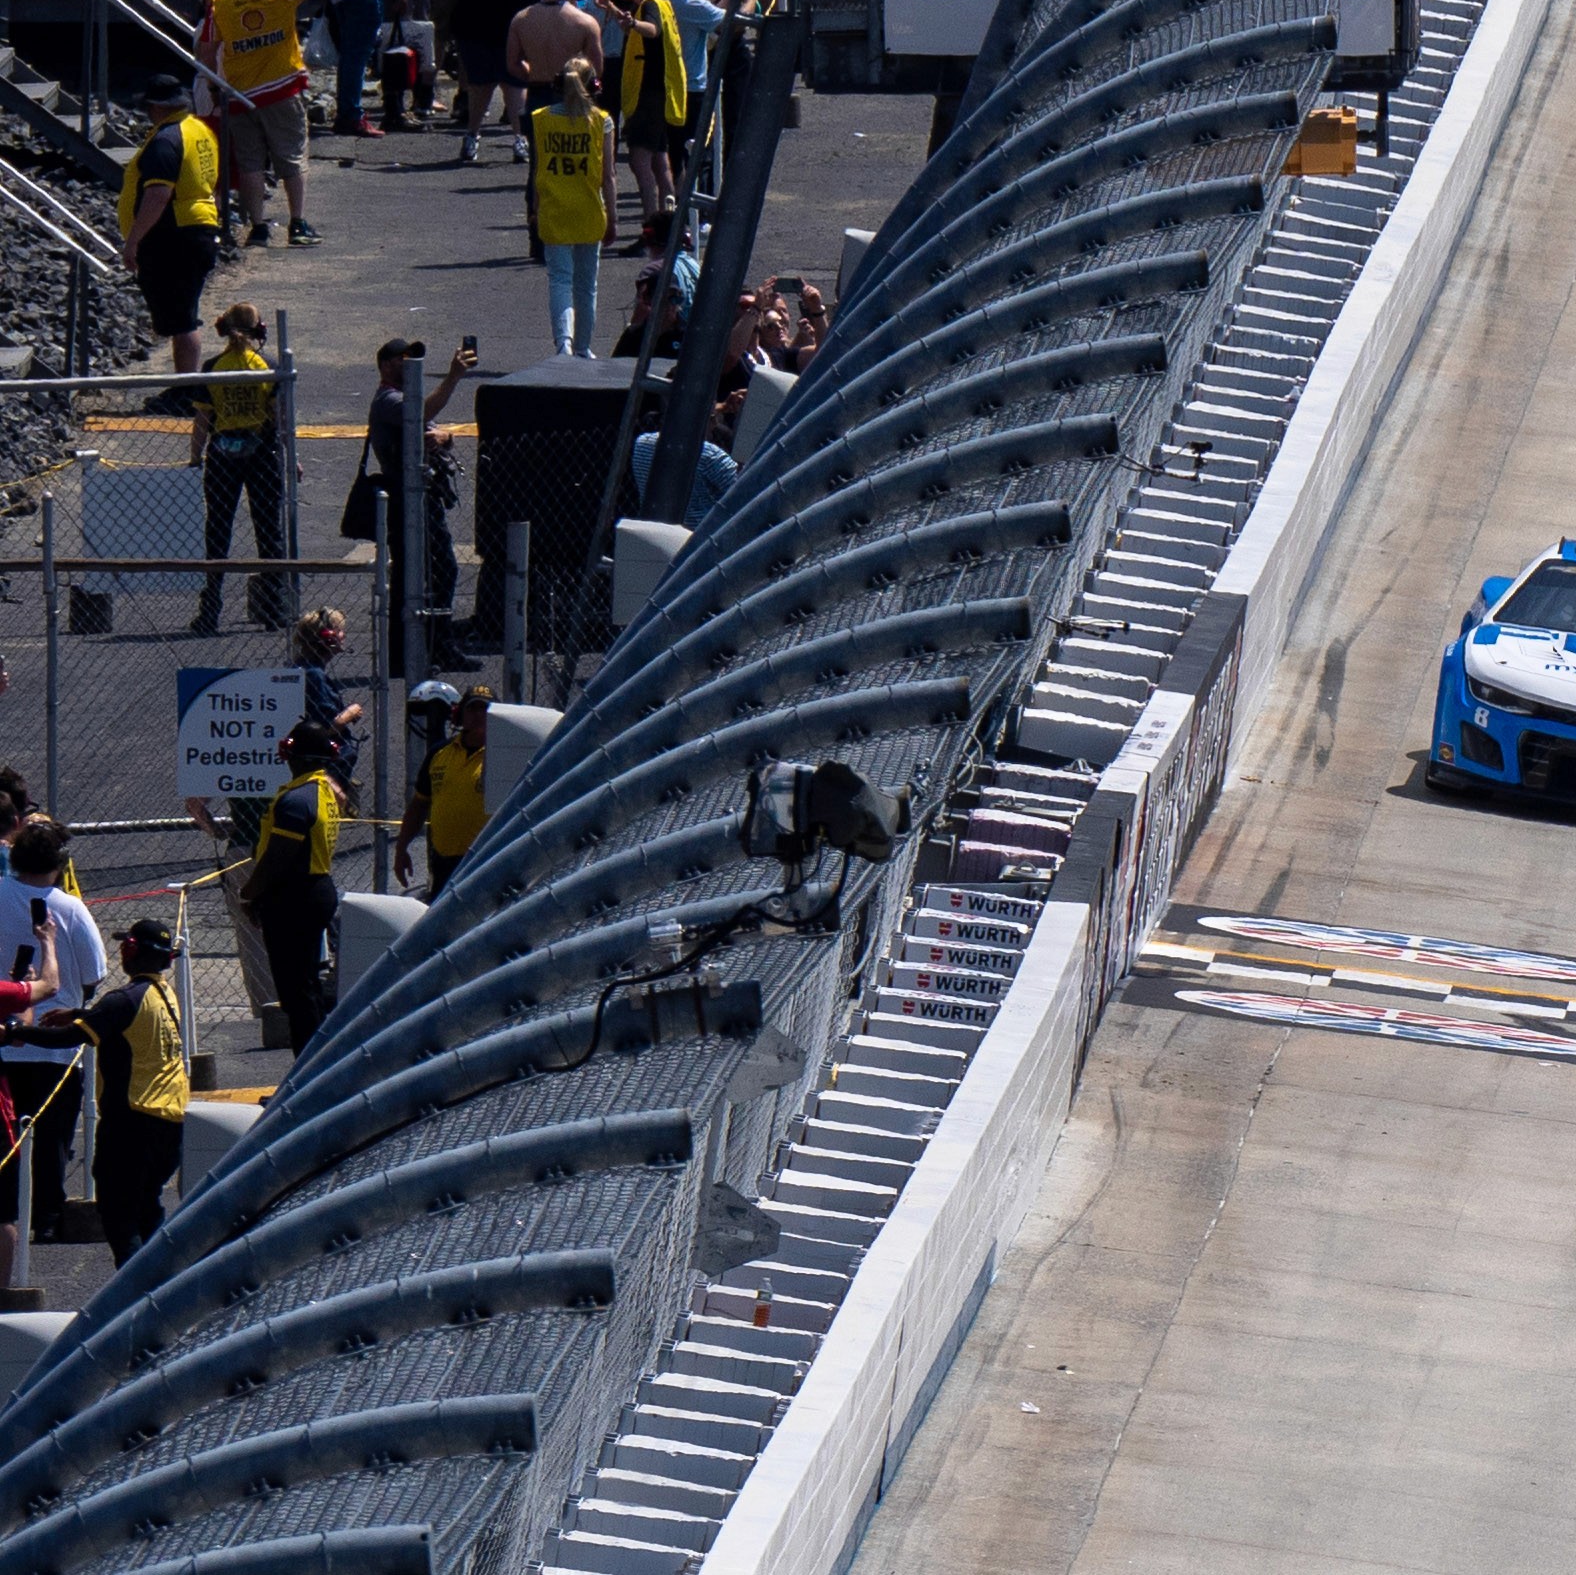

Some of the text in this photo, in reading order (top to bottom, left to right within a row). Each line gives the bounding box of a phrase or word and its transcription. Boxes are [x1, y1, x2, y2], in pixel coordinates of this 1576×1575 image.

[207, 694, 277, 712] This is
[1474, 707, 1490, 728] 8
[210, 721, 275, 738] NOT a
[186, 747, 287, 765] Pedestria
[218, 775, 266, 792] Gate
[968, 896, 1033, 918] WÜRTH
[958, 923, 1020, 945] WÜRTH
[947, 949, 1012, 970] WÜRTH
[935, 973, 1001, 995] WÜRTH
[920, 1001, 987, 1022] WÜRTH
